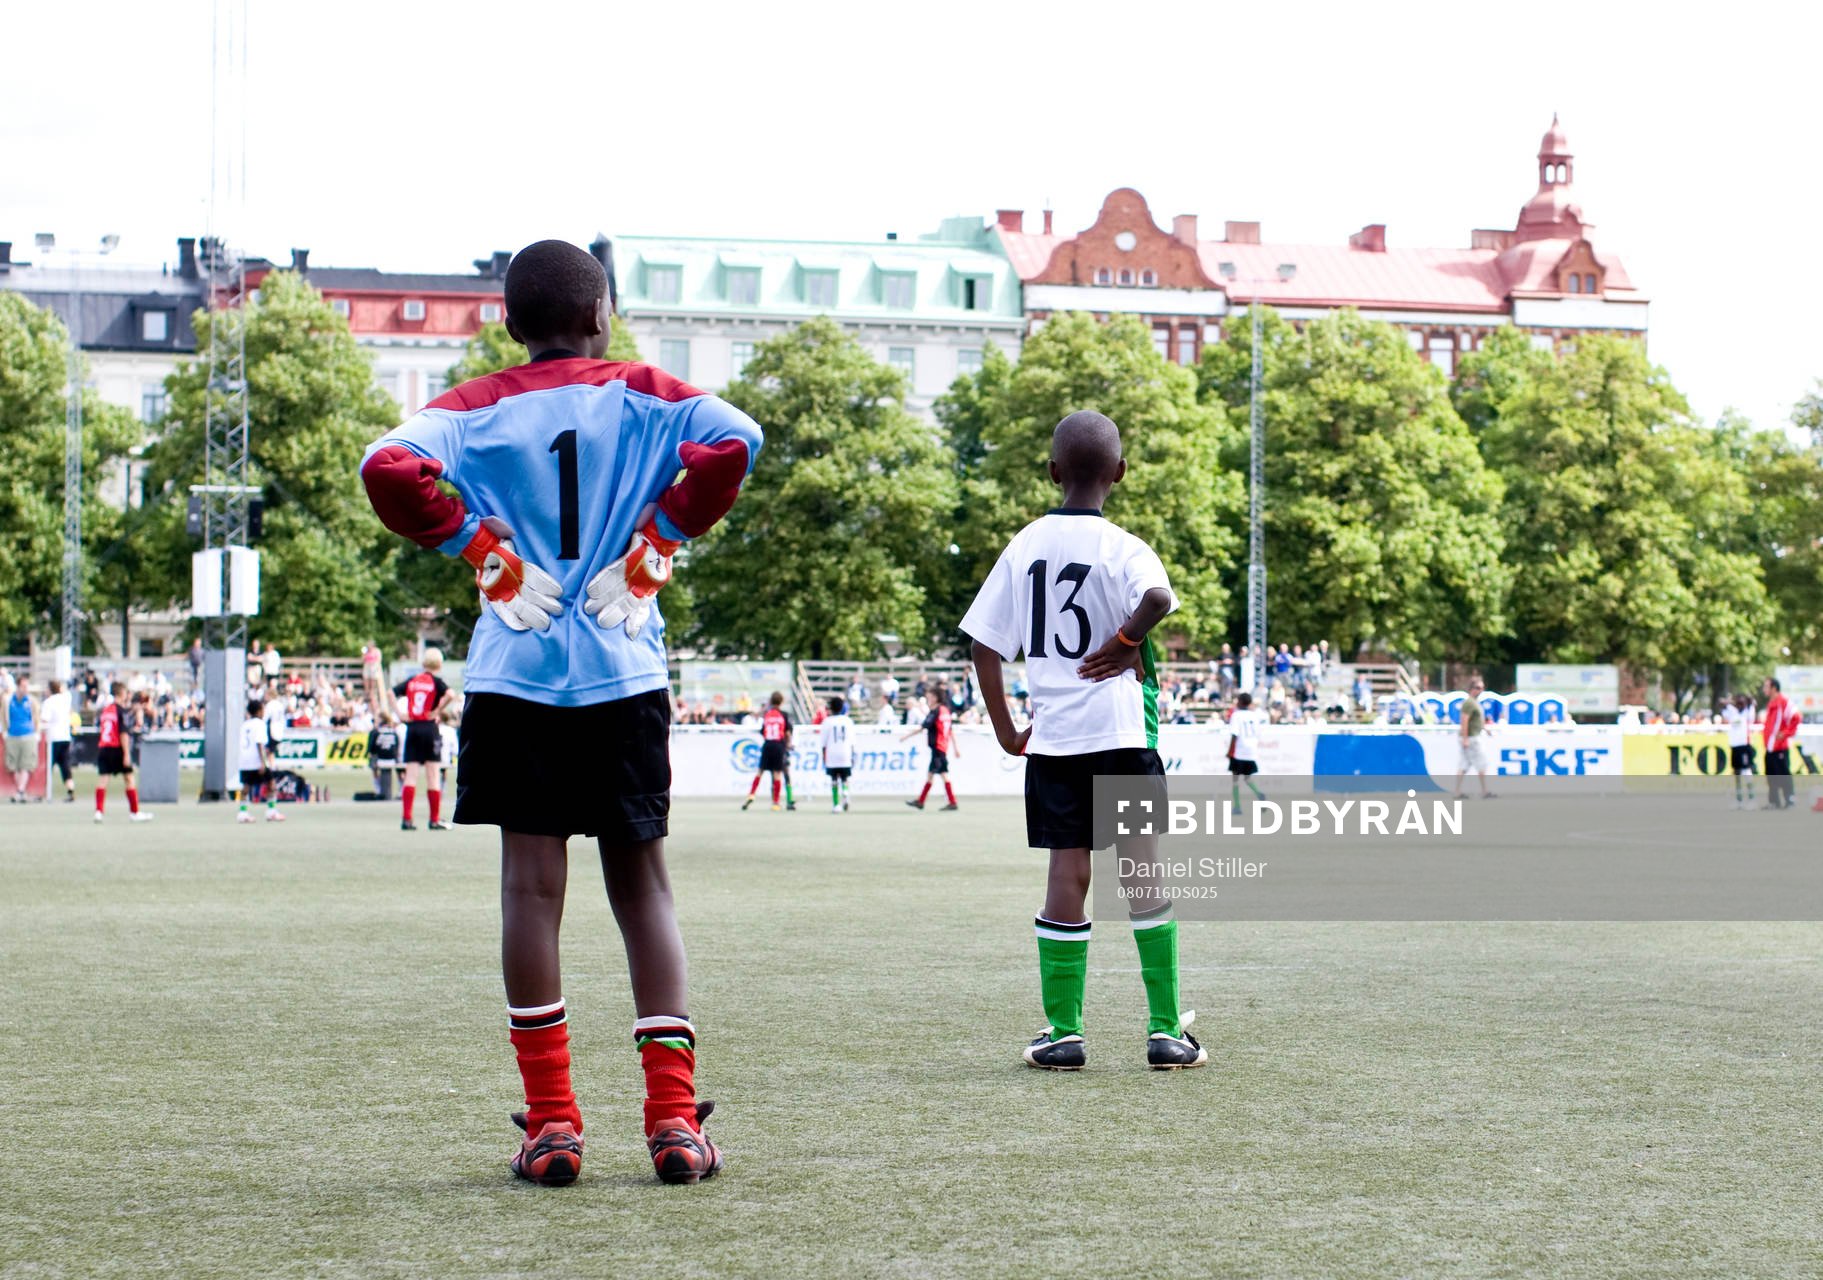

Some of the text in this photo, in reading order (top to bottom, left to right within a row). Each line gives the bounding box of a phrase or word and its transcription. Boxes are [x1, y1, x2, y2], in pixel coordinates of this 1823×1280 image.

[548, 429, 580, 560] 1
[1027, 559, 1092, 660] 13
[327, 740, 371, 759] He
[1498, 748, 1608, 776] SKF
